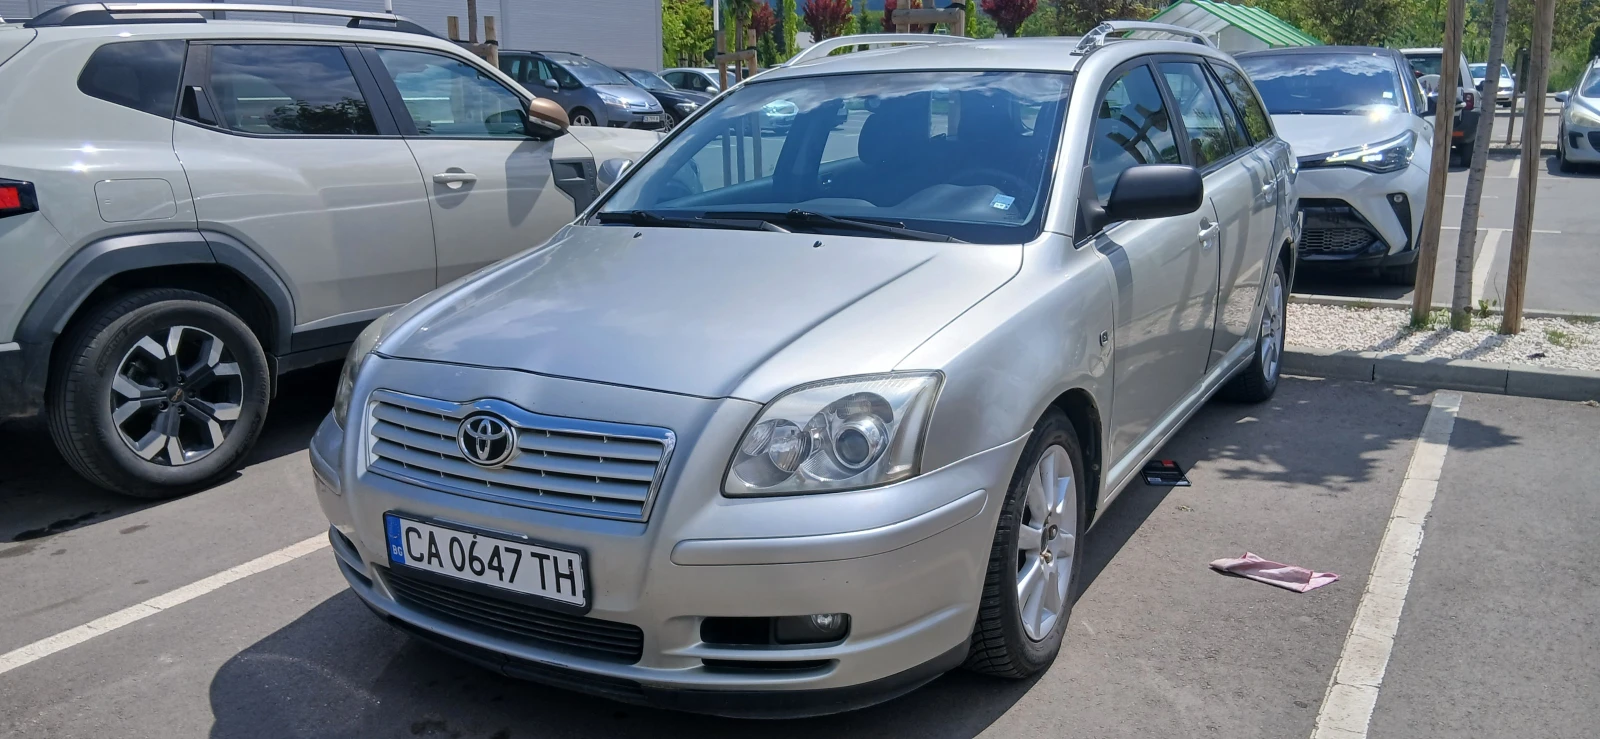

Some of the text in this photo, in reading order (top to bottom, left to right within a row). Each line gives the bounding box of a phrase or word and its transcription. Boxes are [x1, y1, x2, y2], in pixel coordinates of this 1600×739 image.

[392, 544, 404, 557] BG
[405, 526, 577, 597] CA 0647 TH
